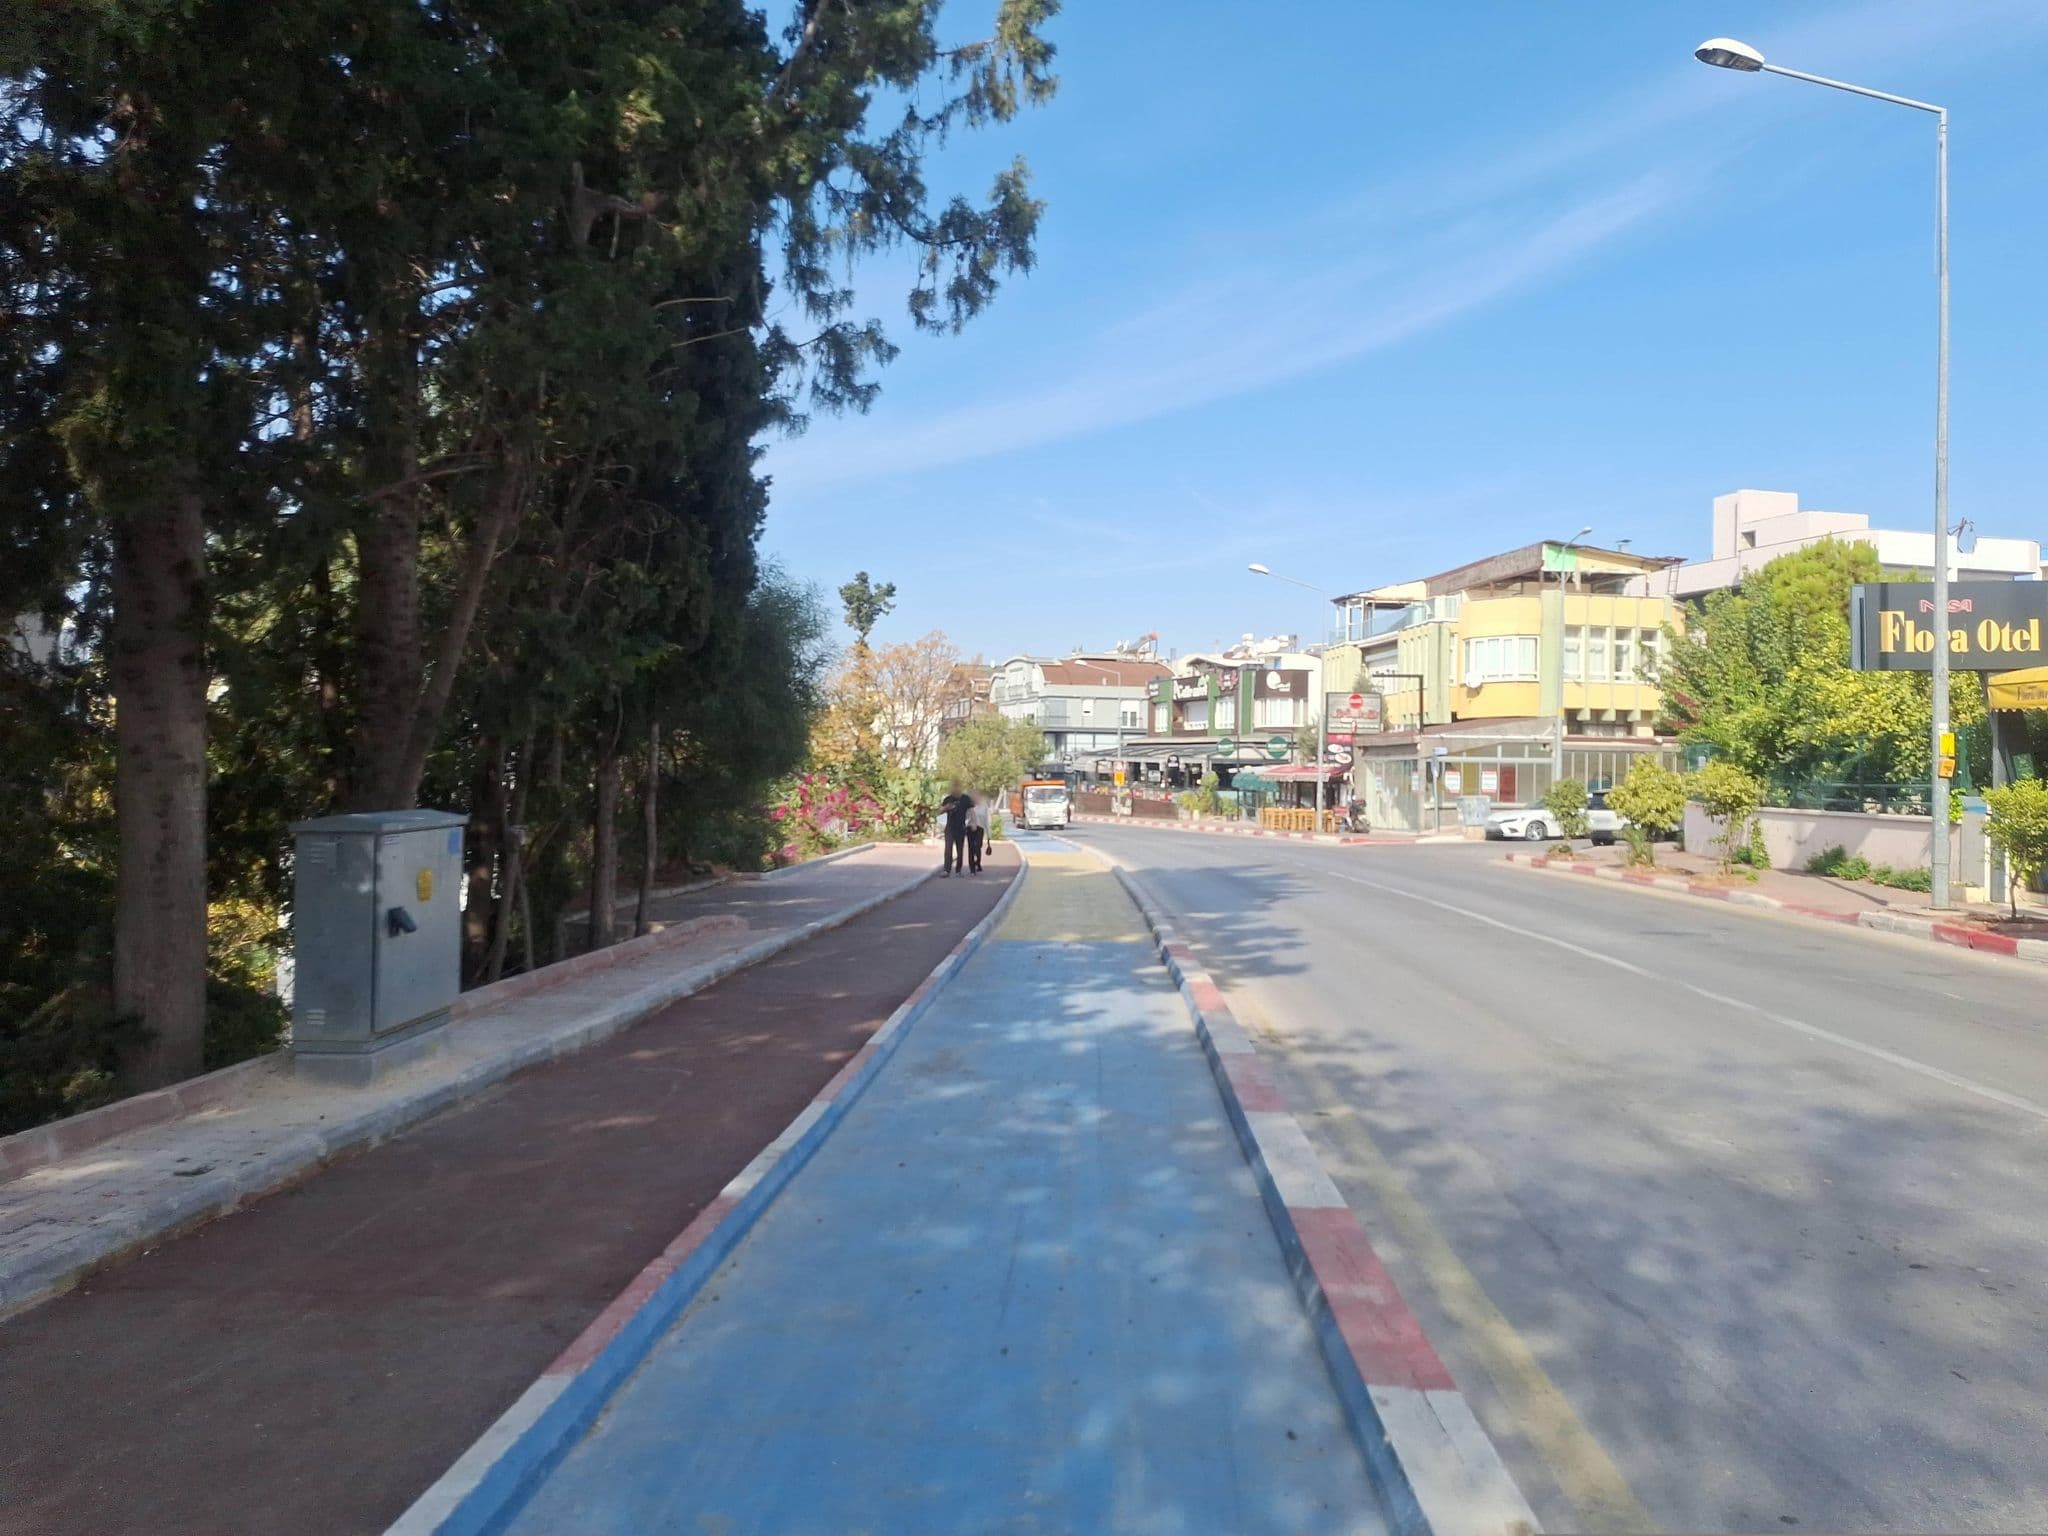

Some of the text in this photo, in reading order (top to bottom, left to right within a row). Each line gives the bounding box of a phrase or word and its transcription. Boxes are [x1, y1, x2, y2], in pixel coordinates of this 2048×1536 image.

[1919, 599, 1973, 613] NSA
[1878, 610, 2041, 653] Floa Otel
